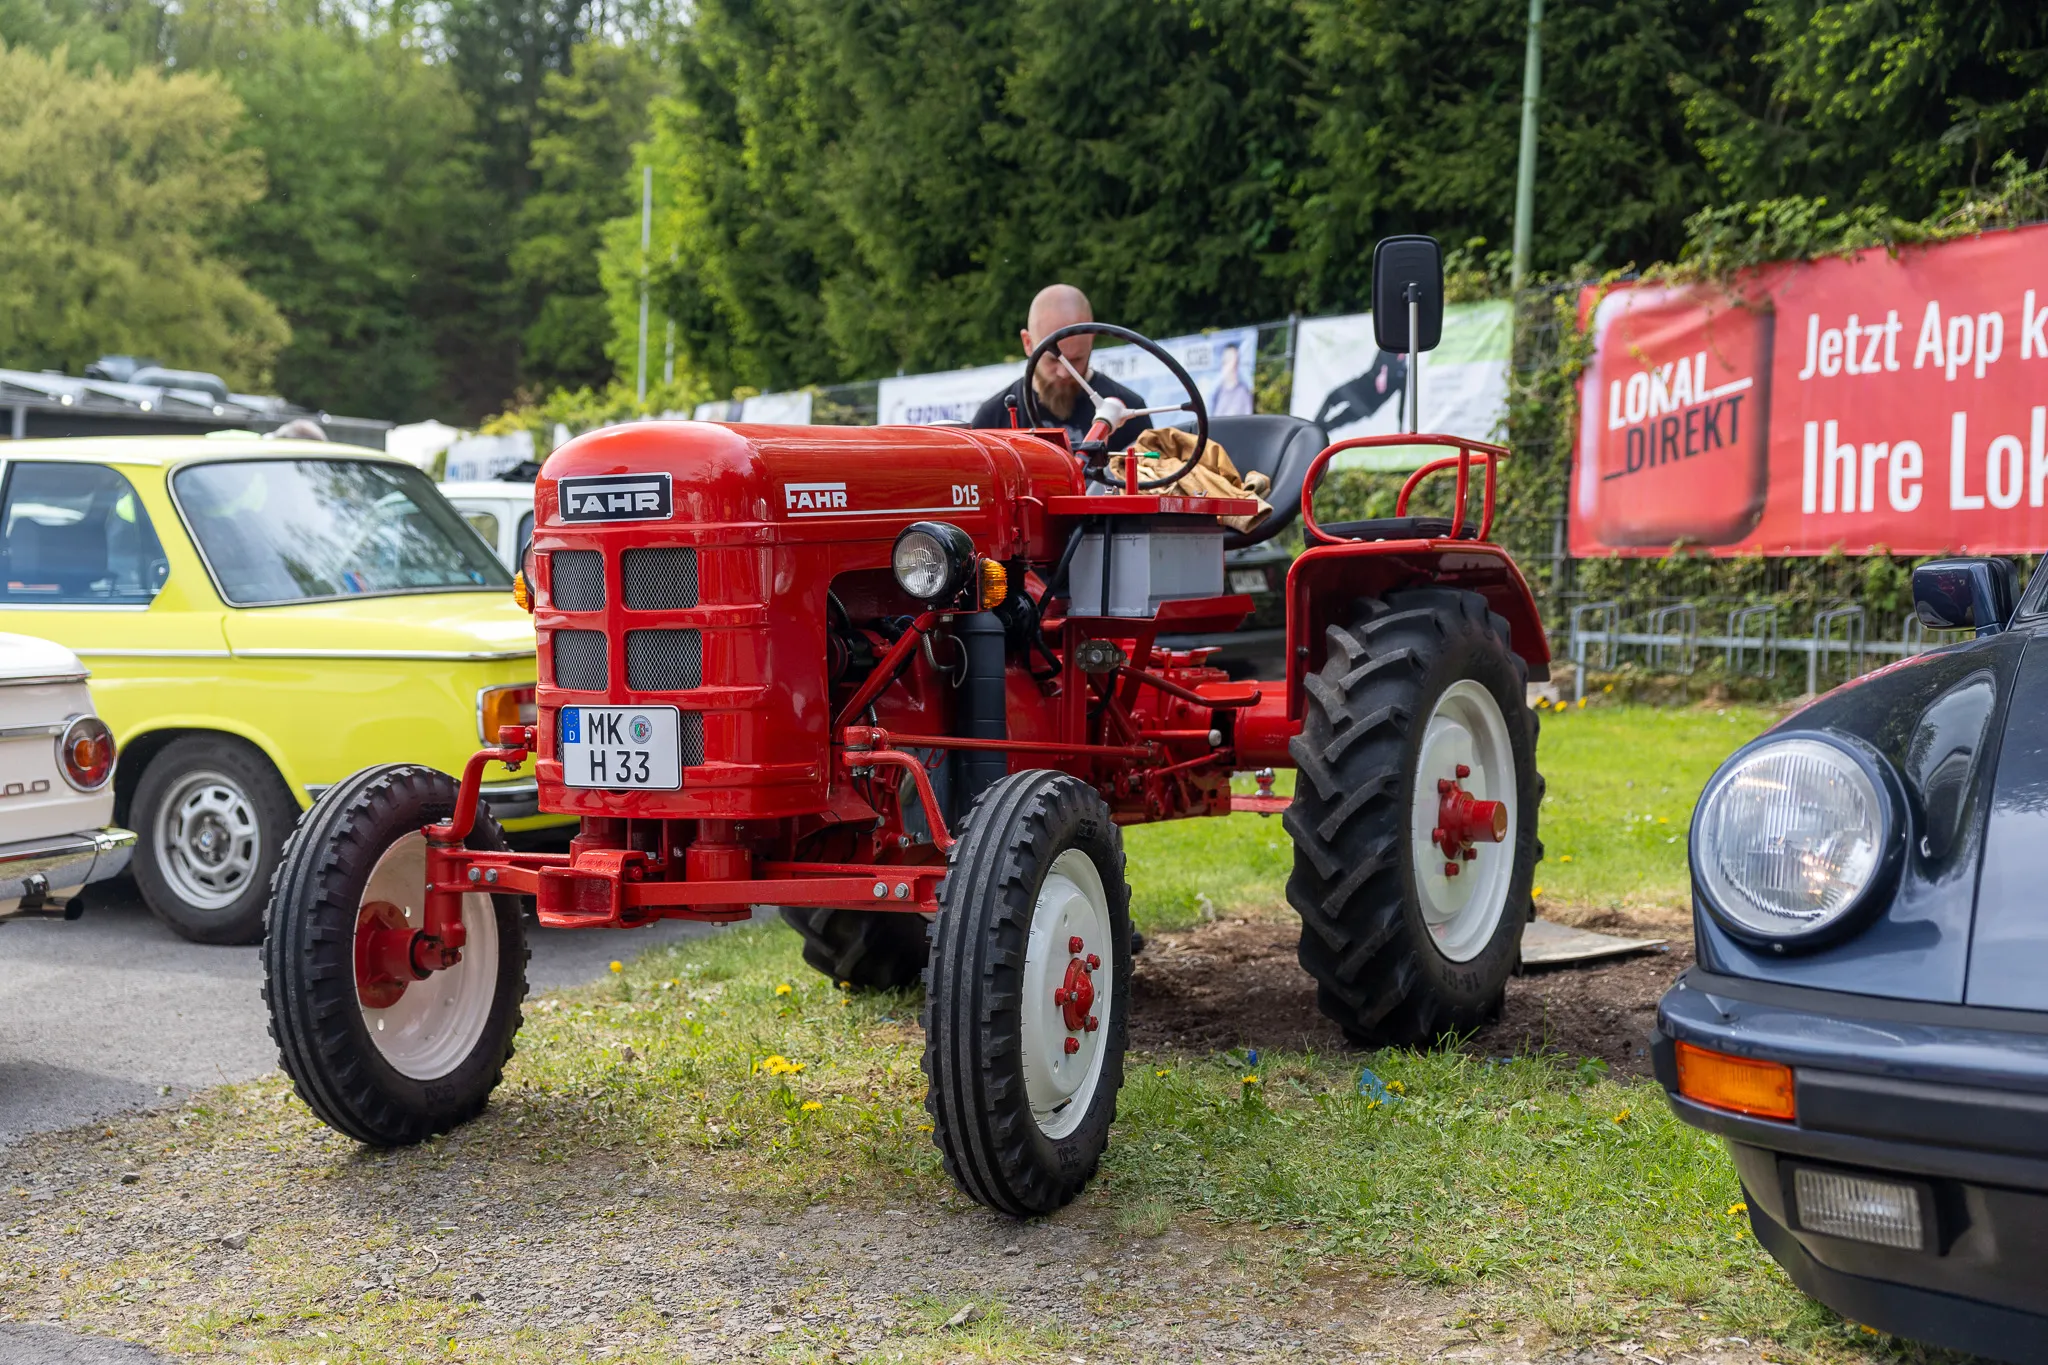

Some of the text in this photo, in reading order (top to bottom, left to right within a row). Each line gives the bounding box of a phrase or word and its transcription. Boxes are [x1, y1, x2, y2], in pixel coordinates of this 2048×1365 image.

[1799, 312, 1903, 381] Jetzt
[1913, 300, 2005, 382] App
[1608, 350, 1713, 431] LOKAL
[1625, 394, 1745, 475] DIREKT
[1802, 419, 1924, 514] Ihre
[566, 482, 661, 514] FAHR
[784, 482, 979, 509] FAHR D15
[568, 730, 576, 741] D
[588, 712, 624, 745] MK
[589, 749, 650, 783] H 33
